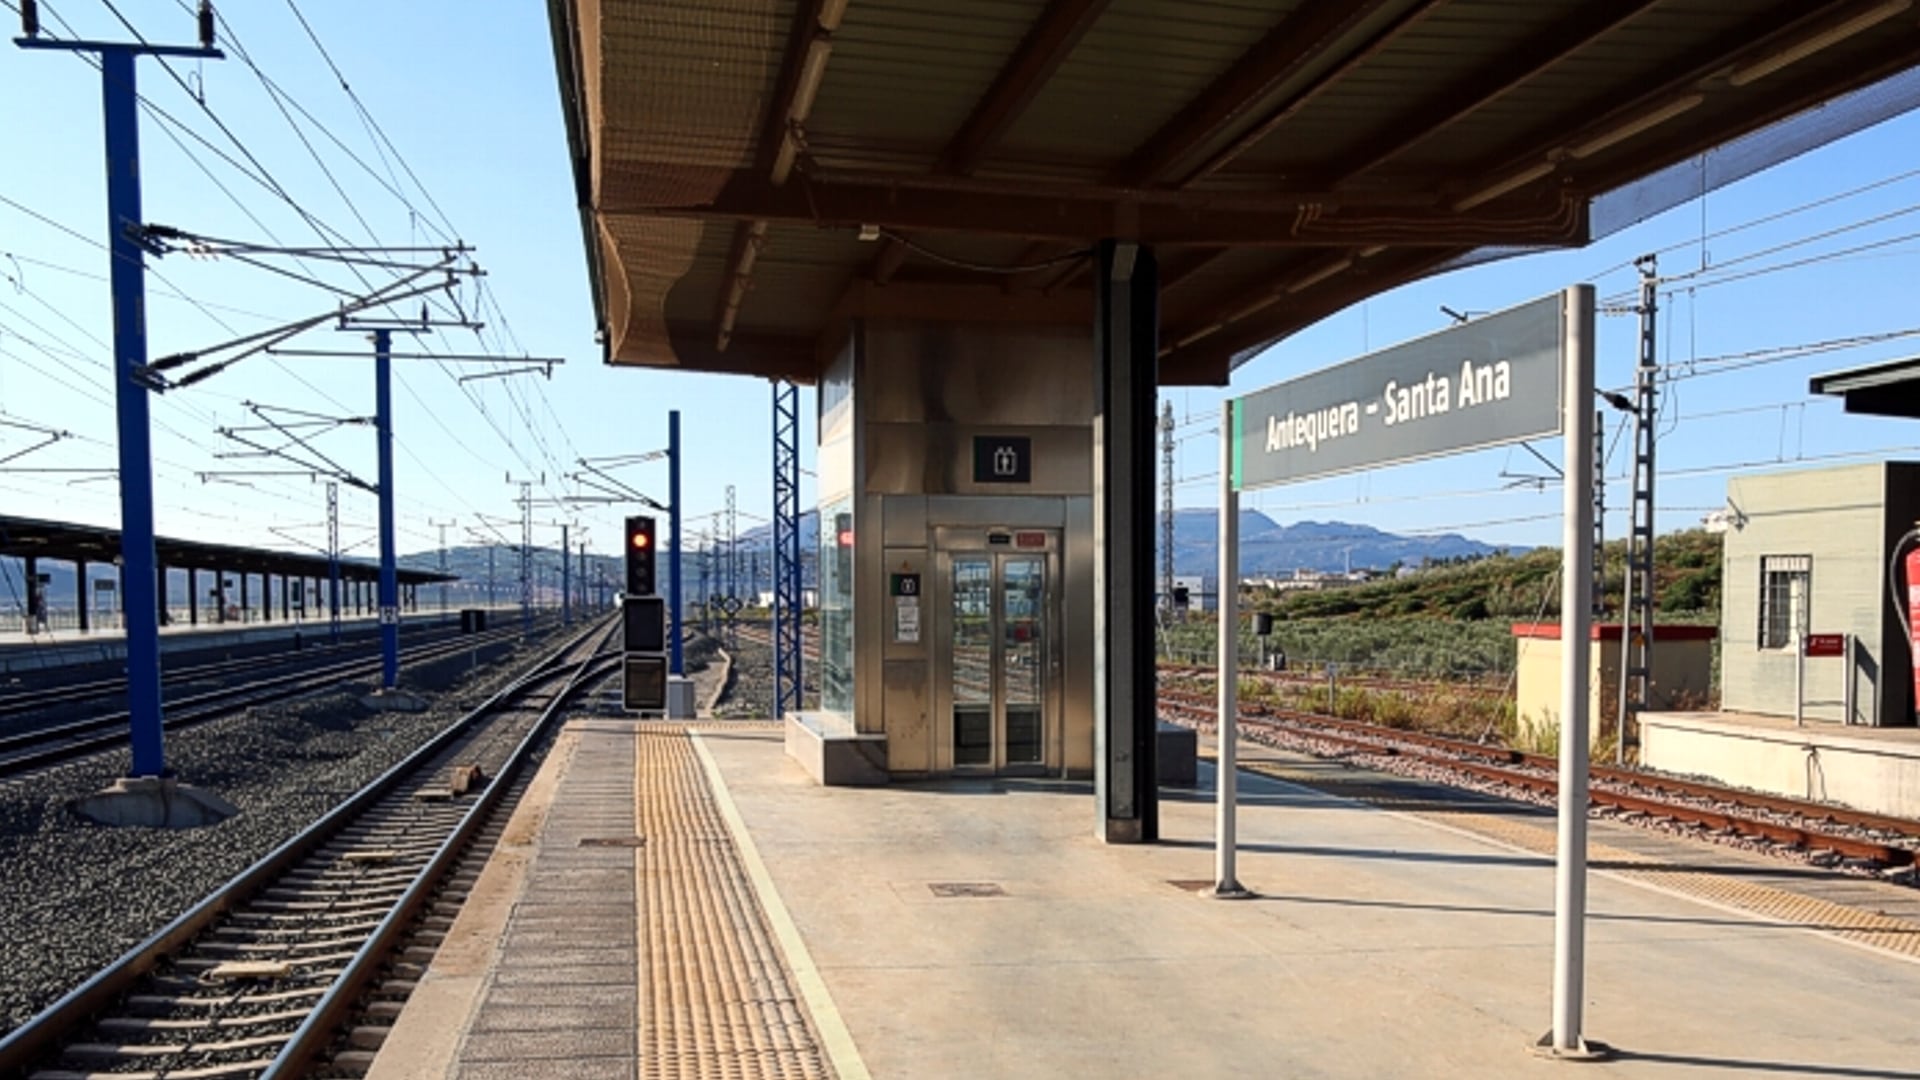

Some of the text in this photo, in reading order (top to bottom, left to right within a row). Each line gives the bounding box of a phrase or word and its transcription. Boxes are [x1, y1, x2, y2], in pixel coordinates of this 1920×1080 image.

[1265, 401, 1359, 452] Antequera
[1384, 372, 1450, 426] Santa
[1458, 359, 1511, 409] Ana
